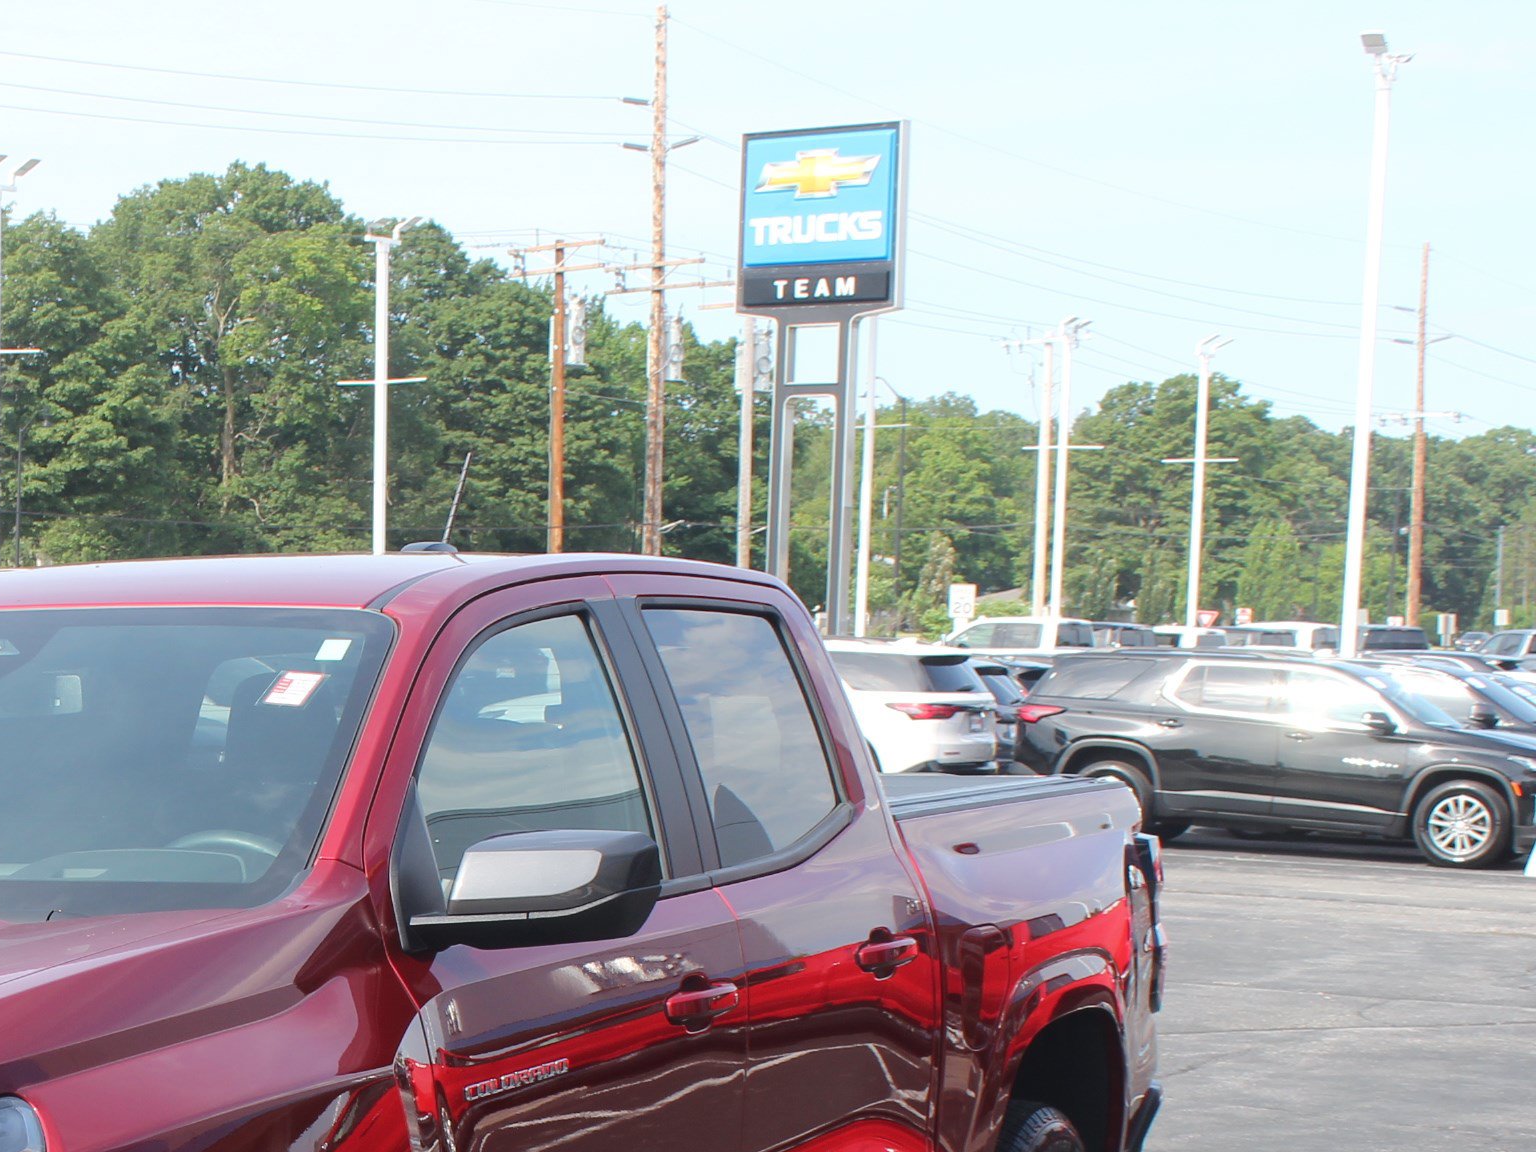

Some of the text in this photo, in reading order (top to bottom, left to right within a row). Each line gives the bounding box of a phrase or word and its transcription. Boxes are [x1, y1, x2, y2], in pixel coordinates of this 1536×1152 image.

[749, 210, 882, 246] TRUCKS
[773, 276, 857, 299] TEAM
[953, 601, 971, 614] 20
[464, 1058, 570, 1101] COLORADO
